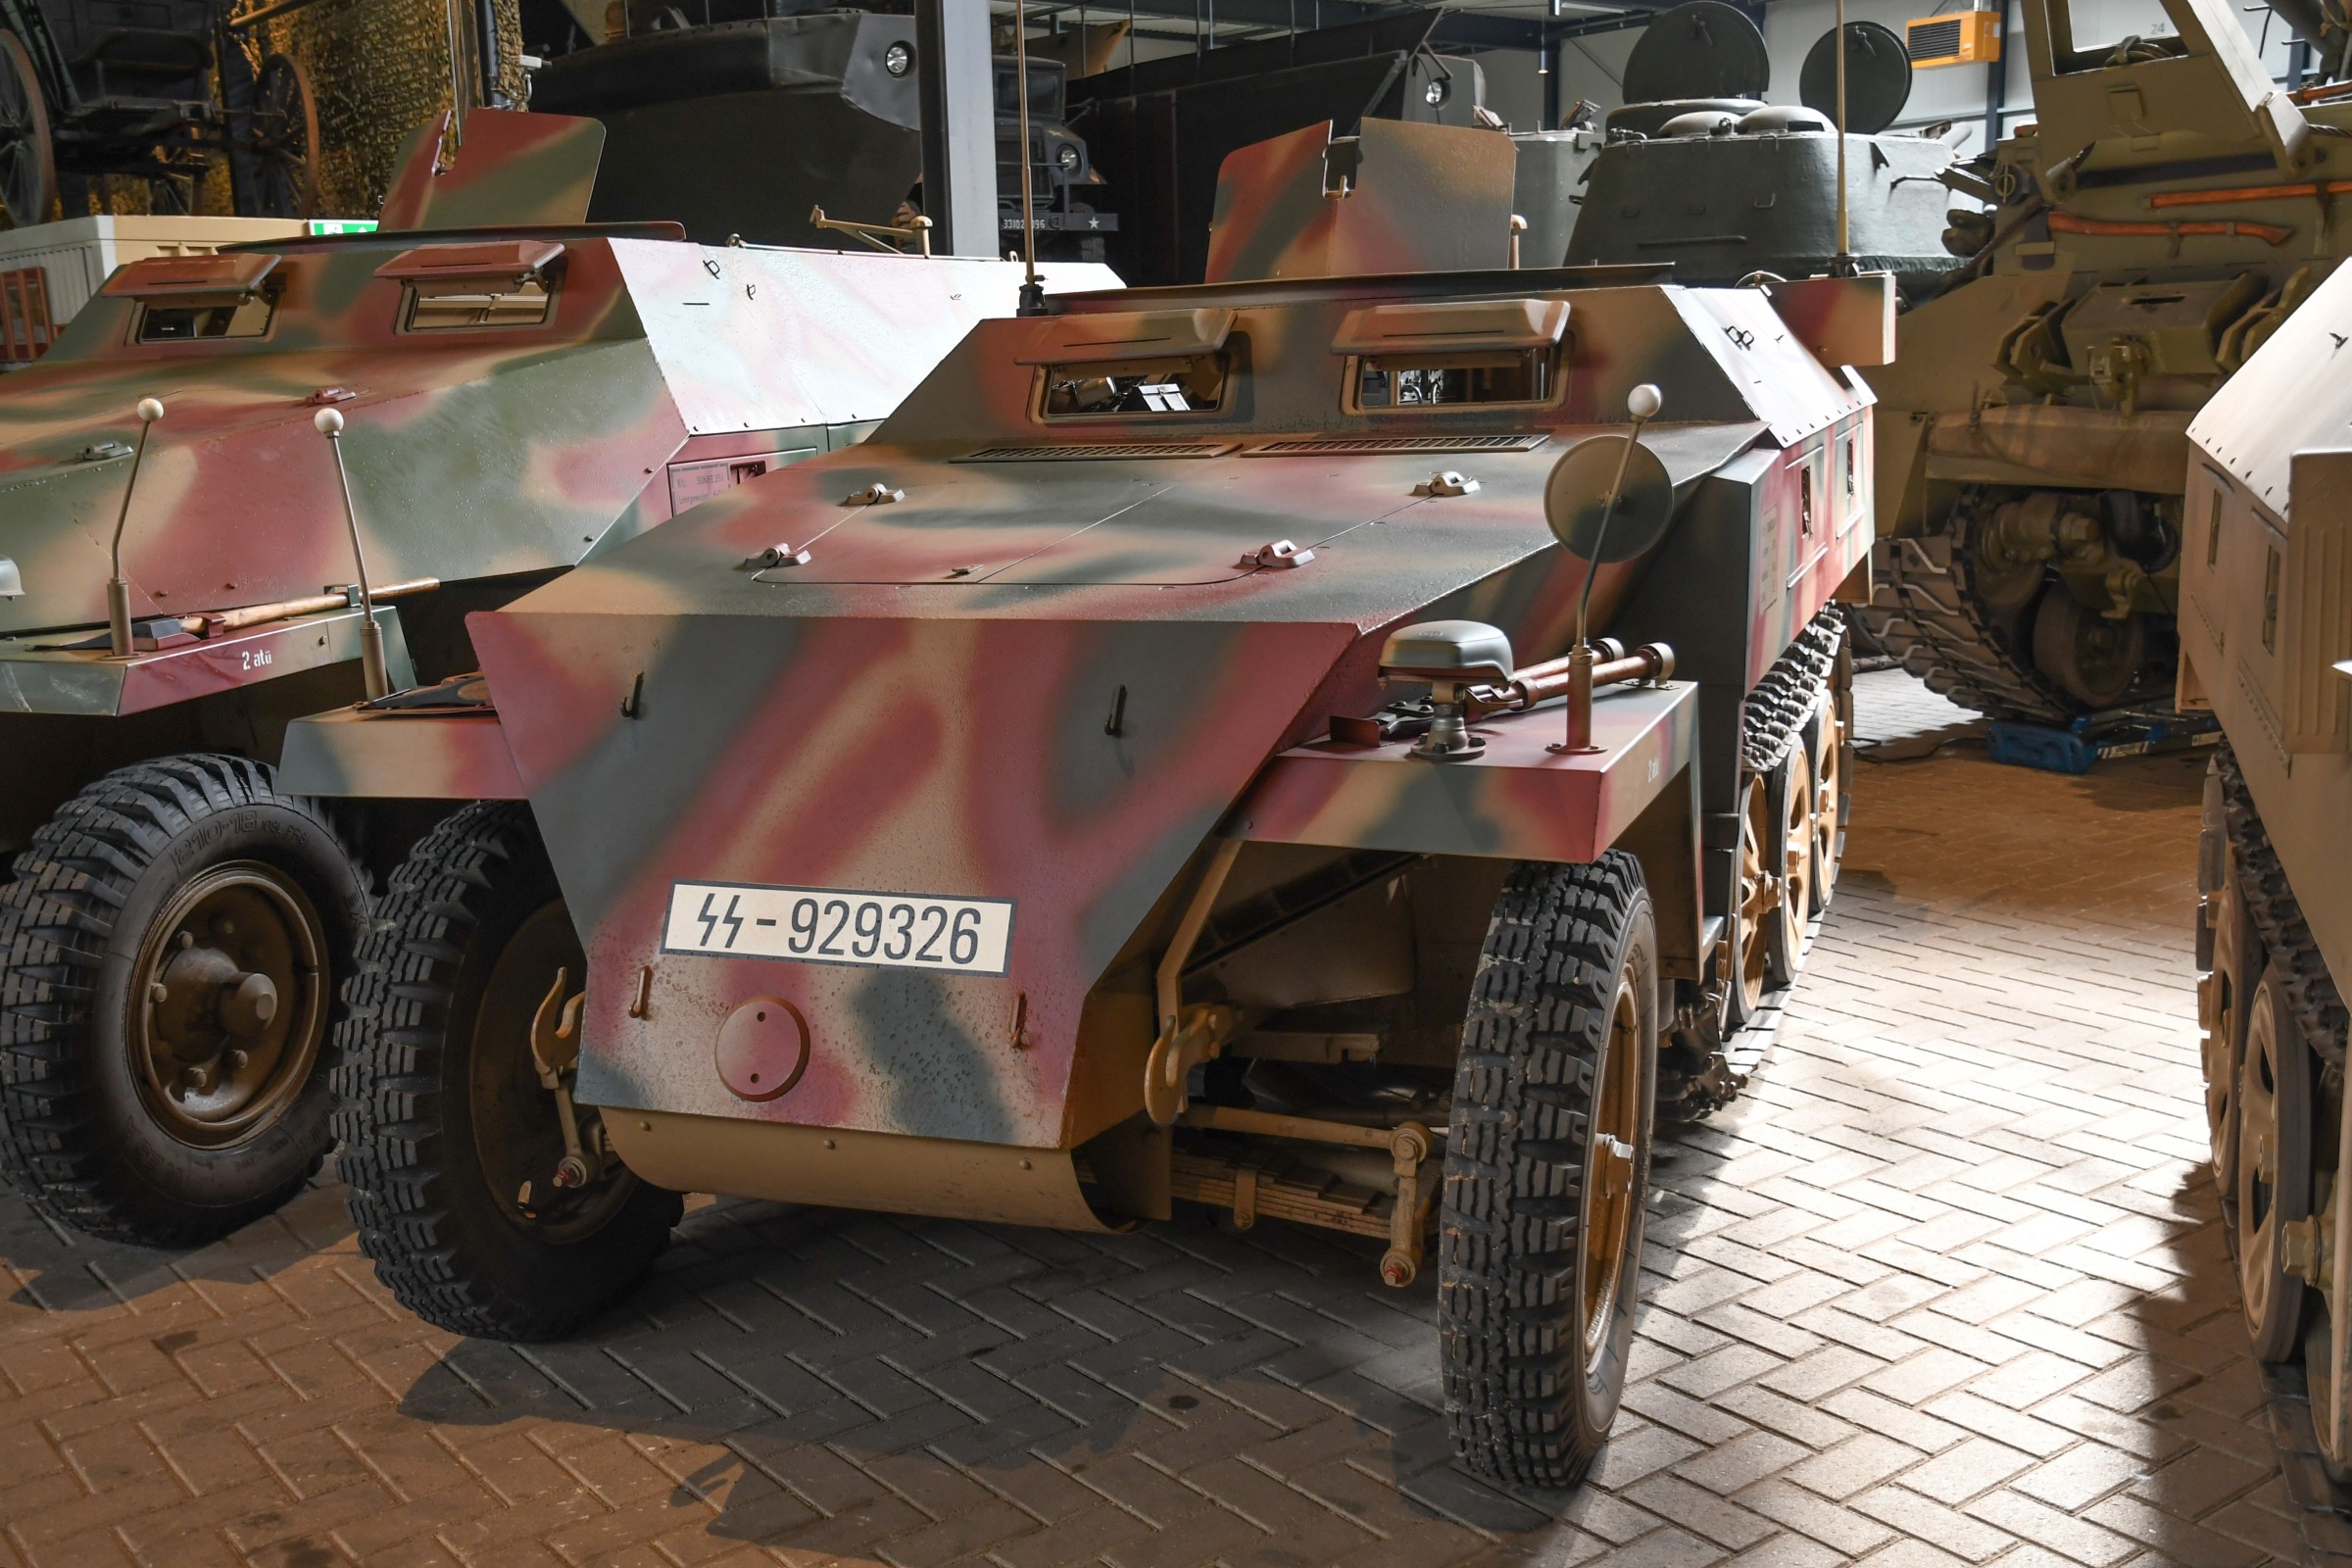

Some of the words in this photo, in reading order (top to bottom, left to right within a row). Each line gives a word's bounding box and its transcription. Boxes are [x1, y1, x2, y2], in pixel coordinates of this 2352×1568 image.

[242, 651, 251, 671] 2
[254, 649, 272, 667] atü
[174, 810, 258, 866] 210-18
